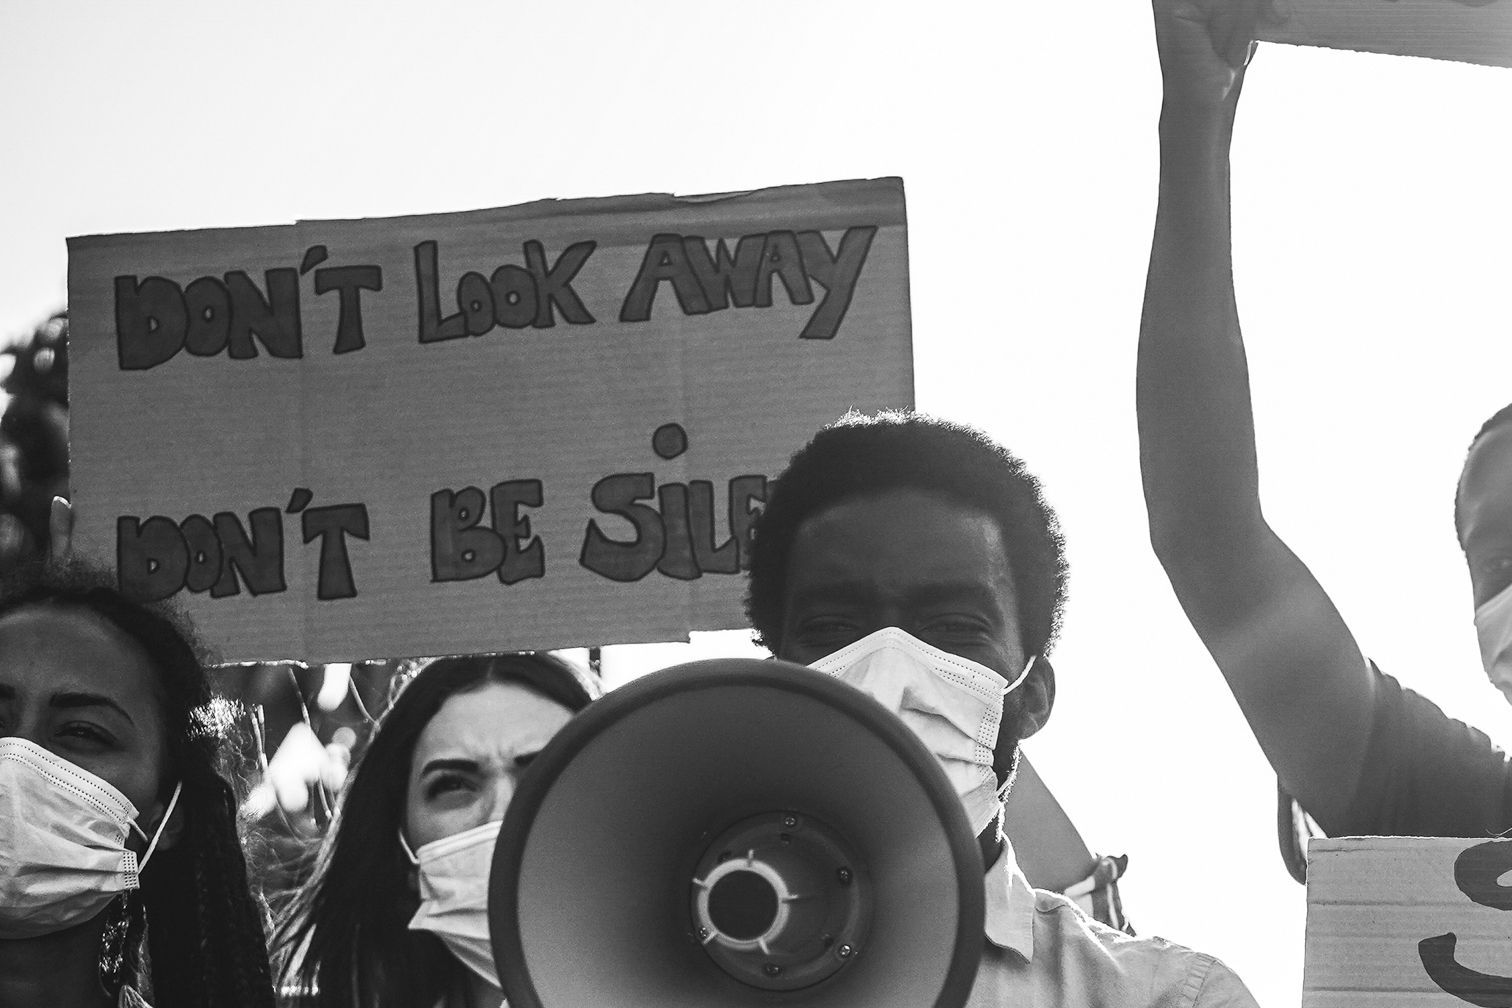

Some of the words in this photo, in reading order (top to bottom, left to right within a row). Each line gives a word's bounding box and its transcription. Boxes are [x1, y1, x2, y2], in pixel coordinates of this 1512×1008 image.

[114, 245, 383, 370] DON'T
[619, 225, 878, 340] AWAY
[116, 487, 370, 600] DON'T
[430, 479, 546, 585] BE
